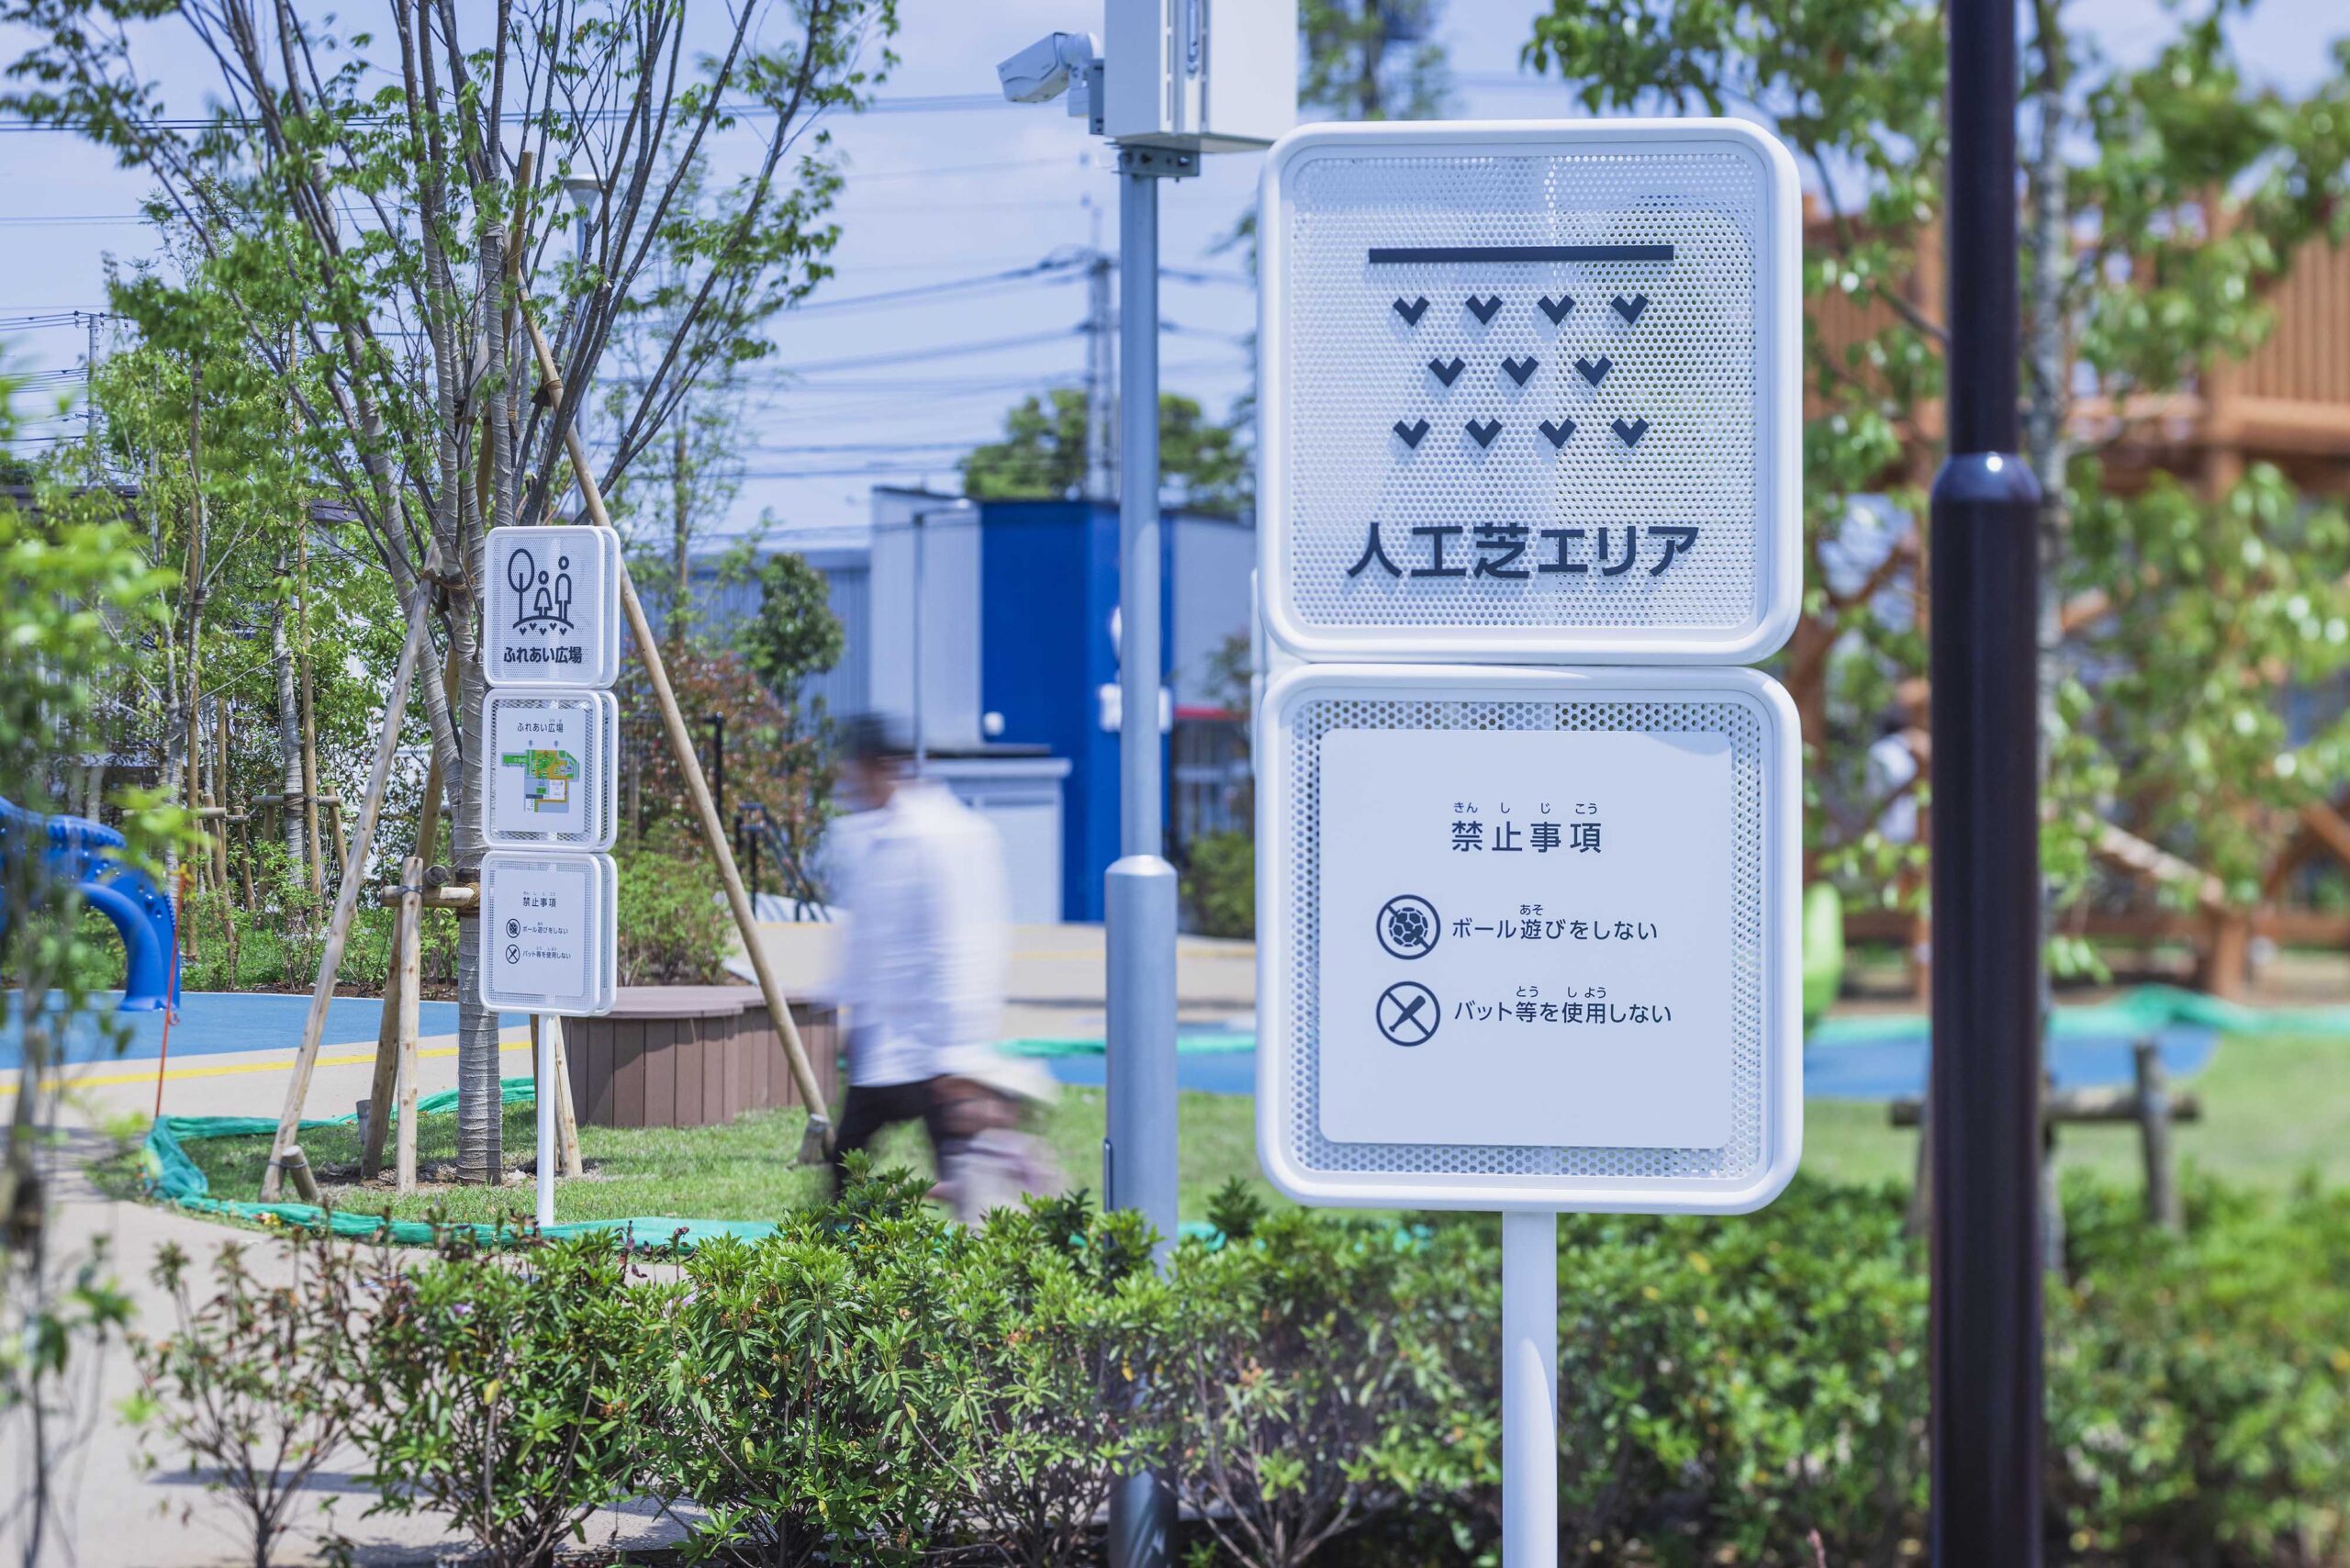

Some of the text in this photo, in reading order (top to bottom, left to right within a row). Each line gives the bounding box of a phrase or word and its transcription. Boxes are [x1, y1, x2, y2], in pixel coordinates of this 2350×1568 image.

[1347, 521, 1700, 579] 人工芝エリア
[503, 645, 582, 664] ふれあい広場
[517, 722, 564, 734] ふれあい広場
[1454, 801, 1598, 815] きん し じ こう
[1451, 820, 1602, 854] 禁止事項
[1519, 903, 1544, 916] あそ
[1451, 918, 1659, 941] ボール遊びをしない
[1516, 985, 1539, 998] とう
[1454, 1000, 1673, 1025] バット等を使用しない
